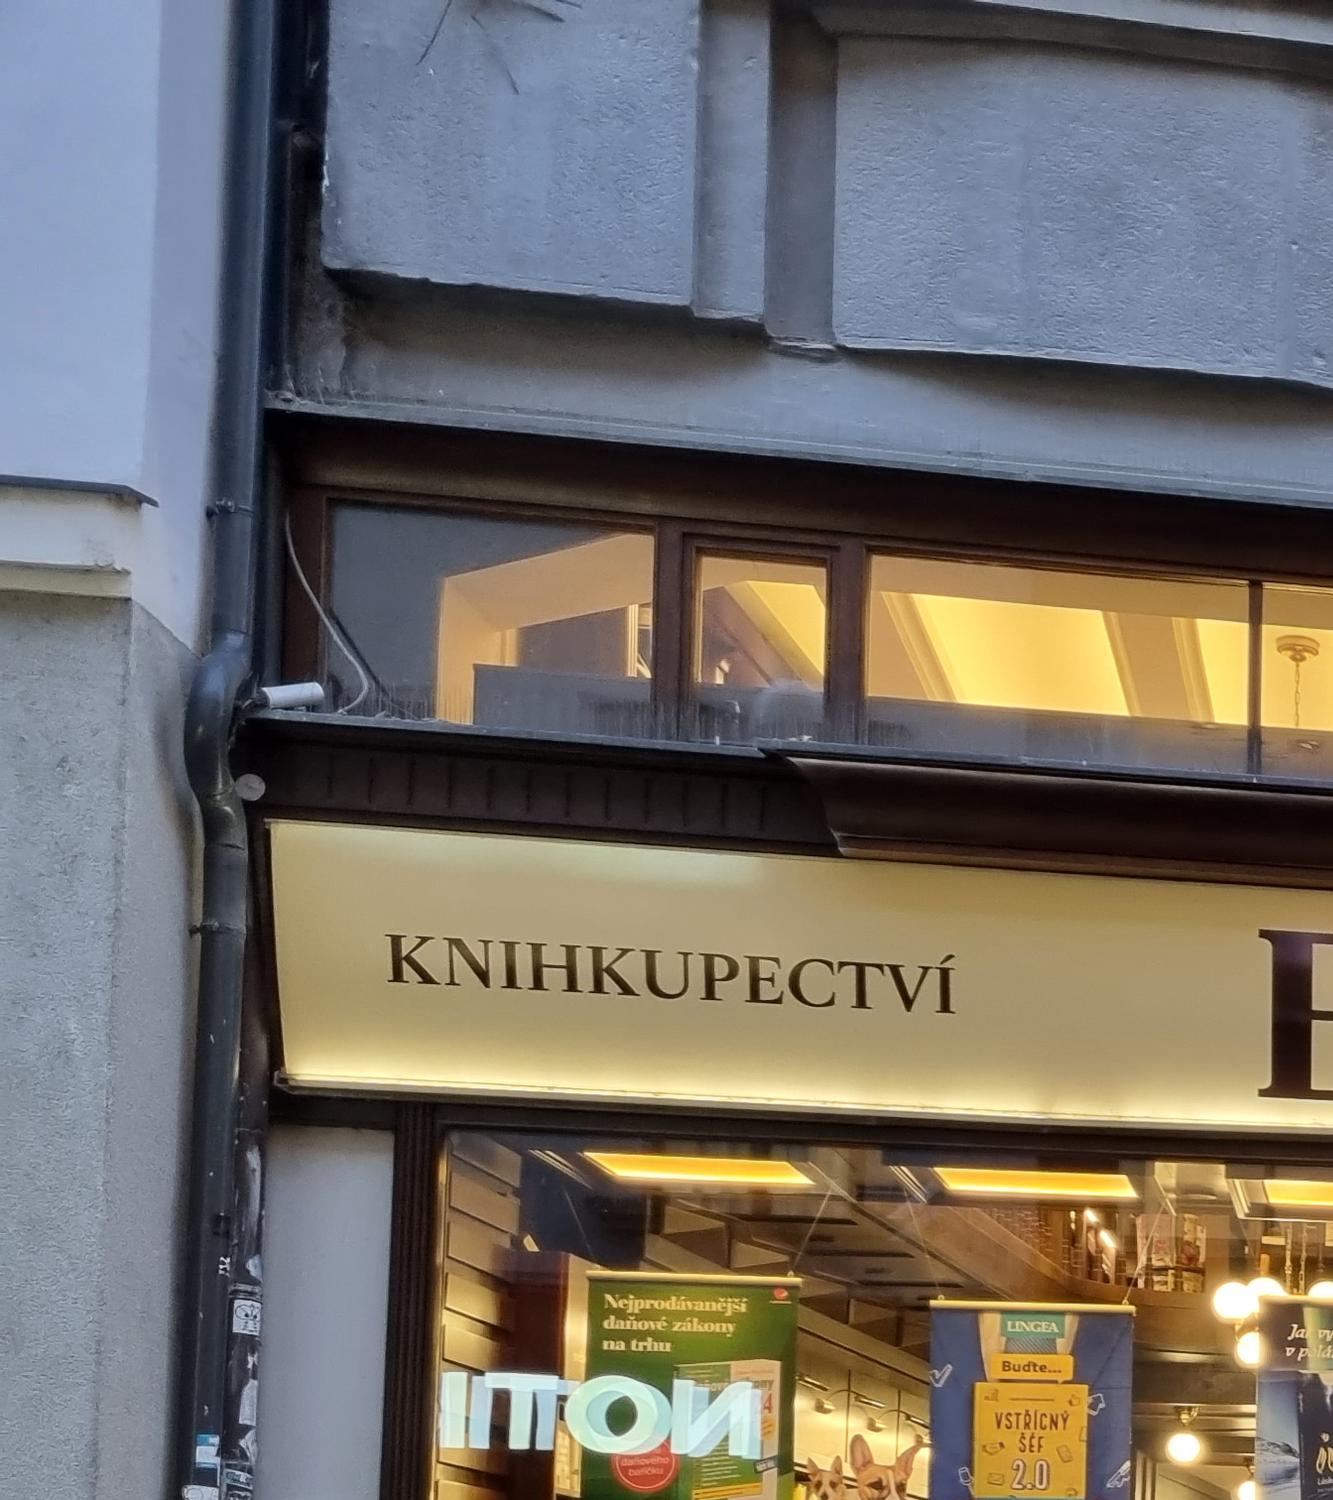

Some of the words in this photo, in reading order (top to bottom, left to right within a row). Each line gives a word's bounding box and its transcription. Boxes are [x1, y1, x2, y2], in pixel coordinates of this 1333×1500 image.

[387, 932, 956, 1015] KNIHKUPECTVÍ
[603, 1293, 748, 1317] Nejprodávanější
[603, 1315, 669, 1331] daňové
[672, 1317, 737, 1338] zákony
[1007, 1320, 1060, 1334] LINGEA
[602, 1338, 626, 1351] na
[631, 1336, 672, 1352] trhu
[1001, 1359, 1063, 1375] Buďte...
[994, 1408, 1071, 1432] VSTŘÍCNÝ
[1018, 1432, 1045, 1454] ŠÉF
[1010, 1457, 1050, 1491] 2.0
